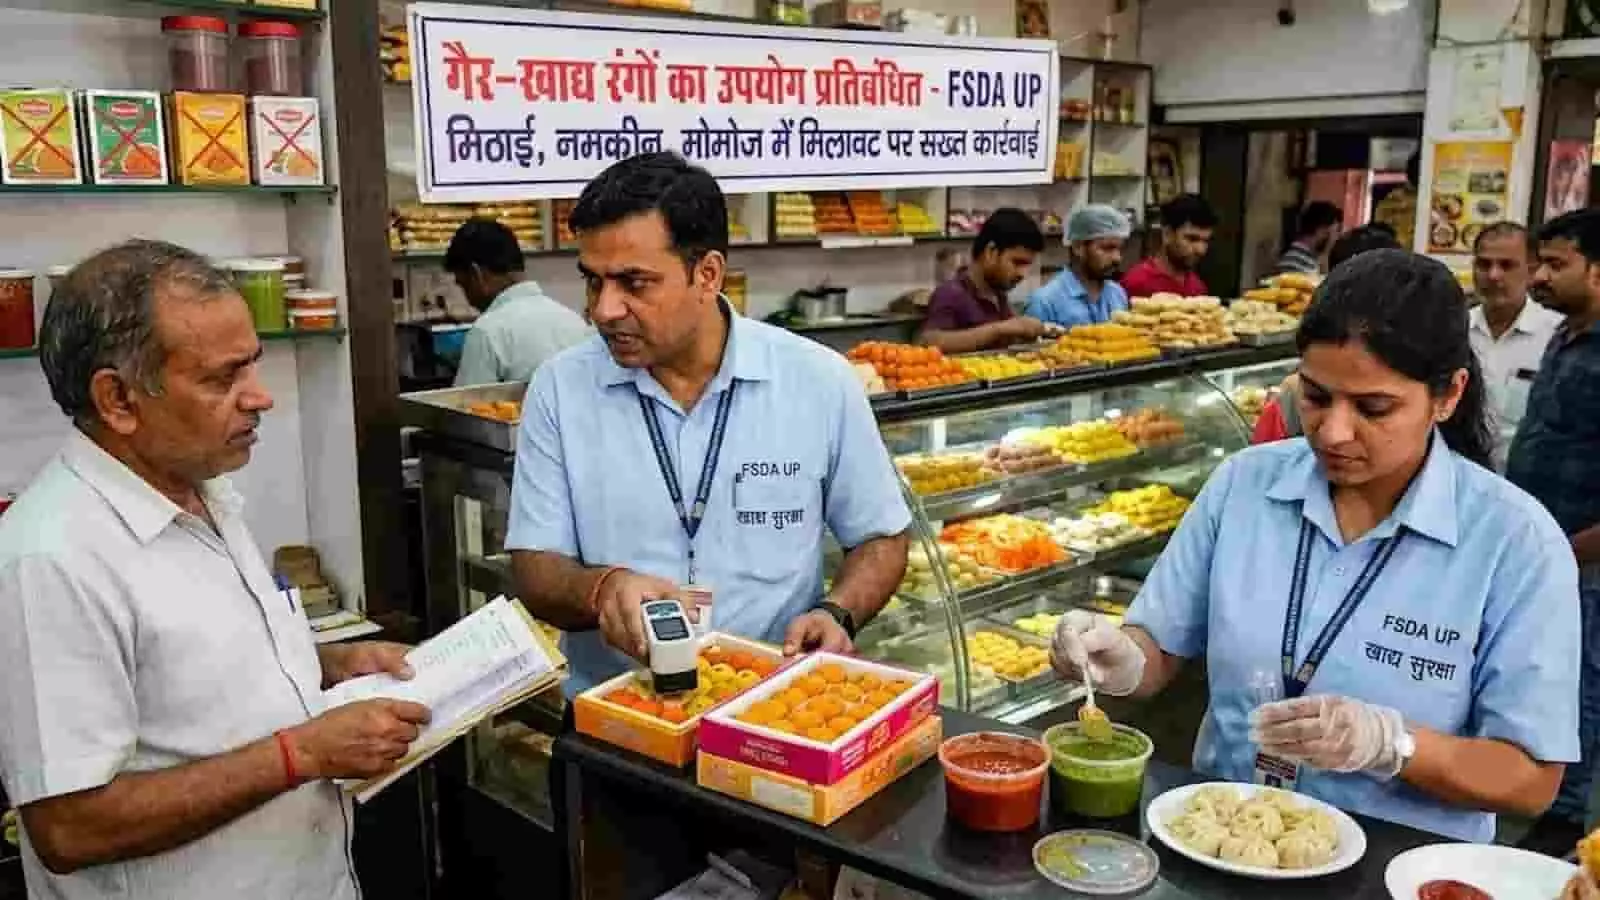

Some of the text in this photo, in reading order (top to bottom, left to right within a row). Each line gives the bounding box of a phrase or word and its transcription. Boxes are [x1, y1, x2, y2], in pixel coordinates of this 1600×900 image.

[442, 41, 597, 102] गैर-खाद्य
[605, 48, 660, 103] रंगों
[666, 64, 708, 104] का
[714, 54, 807, 105] उपयोग
[814, 58, 923, 107] प्रतिबंधित
[947, 69, 1003, 108] FSDA
[1013, 73, 1042, 108] UP
[446, 114, 545, 167] मिठाई,
[680, 117, 764, 161] मोमोज
[771, 119, 795, 158] में
[798, 117, 881, 158] मिलावट
[887, 129, 914, 157] पर
[919, 129, 968, 158] सख्त
[741, 463, 801, 476] FSDA UP
[1382, 615, 1460, 646] FSDA UP
